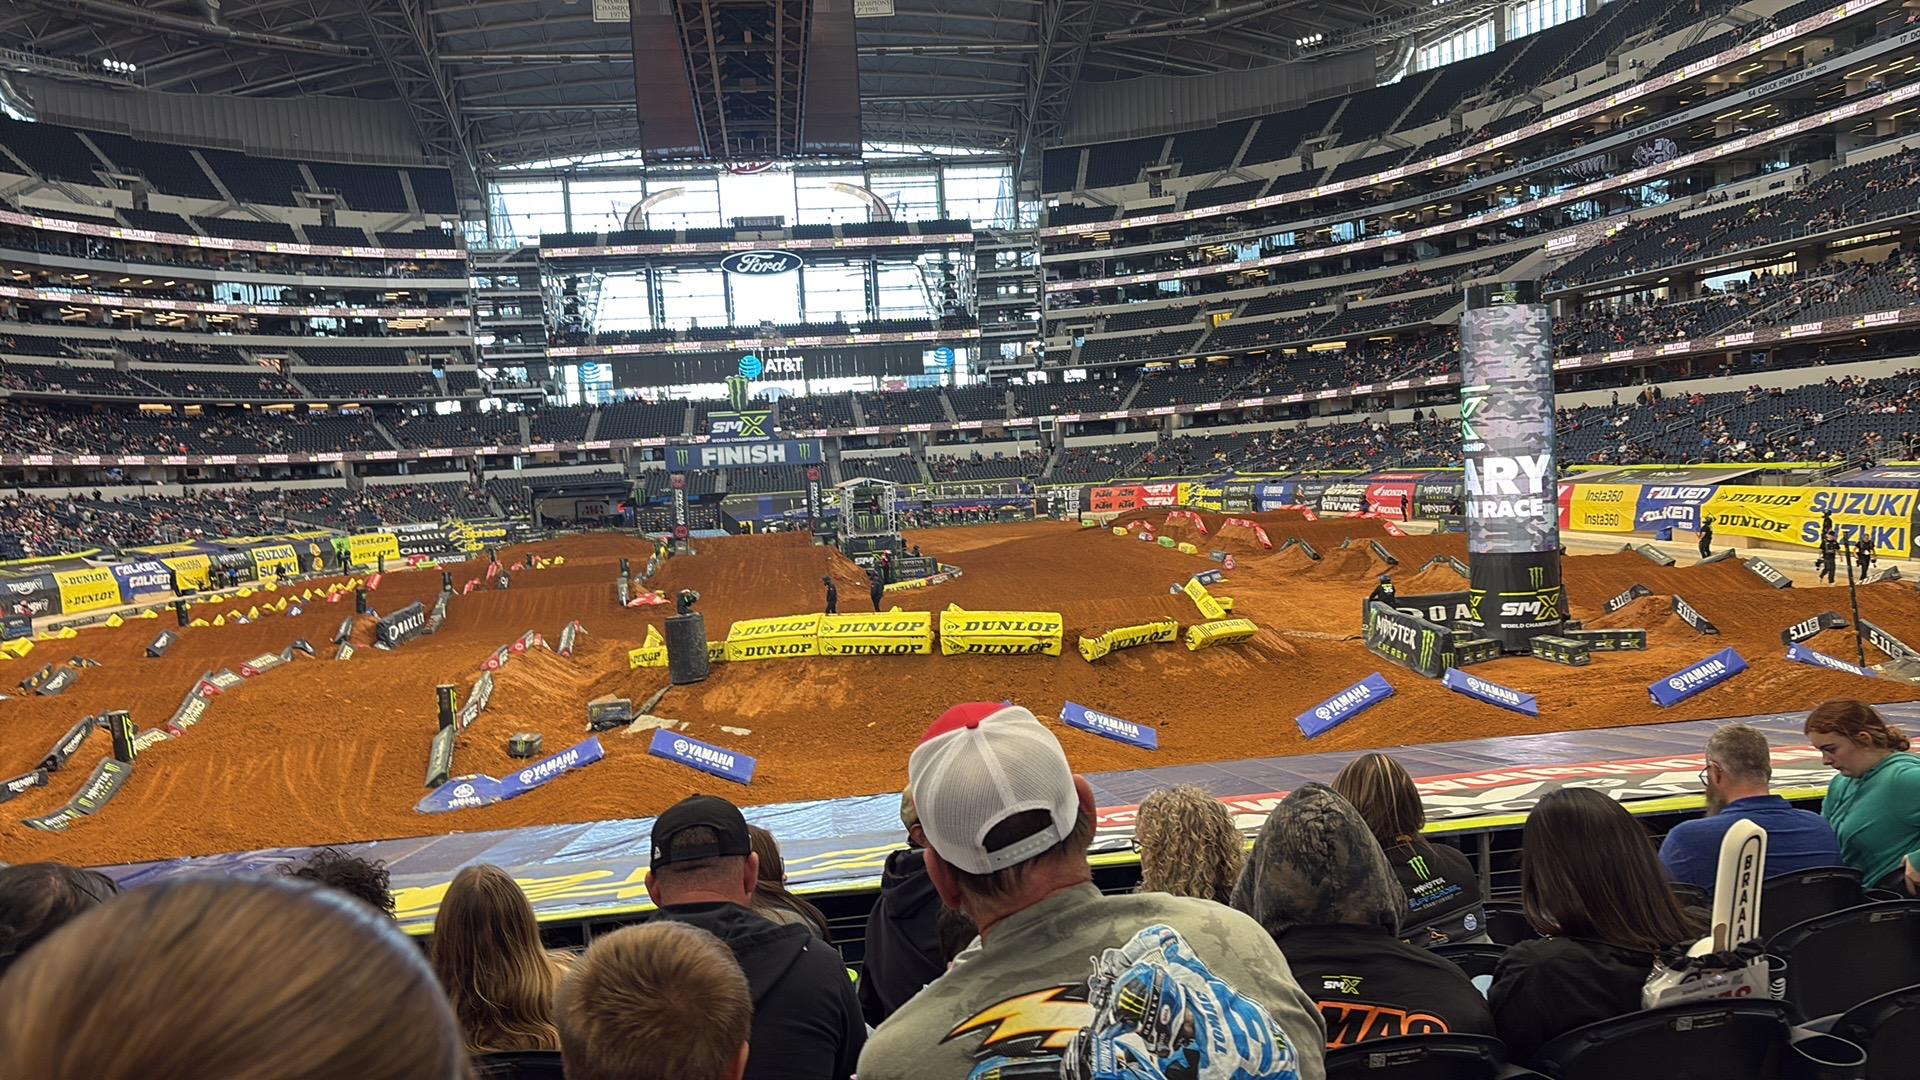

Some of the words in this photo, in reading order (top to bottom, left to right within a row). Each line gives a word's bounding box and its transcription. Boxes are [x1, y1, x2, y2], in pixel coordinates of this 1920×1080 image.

[1761, 24, 1797, 45] MILITARY
[1684, 56, 1718, 77] MILITARY
[1615, 84, 1646, 100] MILITARY
[1748, 89, 1756, 97] 54
[1758, 81, 1778, 94] CHUCK
[1778, 72, 1805, 88] HOWLEY
[1551, 109, 1579, 123] MILITARY
[1636, 128, 1648, 137] MEL
[1649, 120, 1670, 133] RENFRO
[1429, 192, 1440, 200] BOB
[1440, 188, 1458, 198] HAYES
[1547, 234, 1577, 247] MILITARY
[737, 254, 788, 273] Ford
[1864, 310, 1900, 323] MILITARY
[765, 357, 804, 373] AT&T
[712, 416, 767, 437] SMX
[701, 444, 786, 466] FINISH
[1094, 490, 1113, 499] KTM
[1117, 488, 1136, 498] KTM
[1143, 484, 1176, 494] FLY
[1382, 489, 1408, 497] HONDA
[1423, 486, 1453, 495] MONSTER
[1585, 489, 1624, 503] Insta360
[1646, 486, 1711, 500] FALKEN
[1093, 501, 1113, 511] KTM
[1118, 500, 1136, 509] KTM
[1143, 496, 1176, 506] FLY
[1727, 493, 1802, 506] DUNLOP
[1810, 491, 1912, 517] SUZUKI
[1378, 506, 1403, 514] HOND
[1421, 504, 1451, 513] MONSTER
[1482, 499, 1544, 518] RACE
[1640, 506, 1694, 522] FALKEN
[1584, 512, 1619, 527] Insta360
[1718, 514, 1791, 533] DUNLOP
[398, 533, 446, 542] OAKLEY
[255, 547, 295, 561] SUZUKI
[115, 561, 162, 576] FALKEN
[69, 572, 109, 585] DUNLOP
[129, 574, 171, 589] FALKEN
[7, 579, 44, 595] TRIUMPH
[73, 591, 116, 606] DUNLOP
[1500, 593, 1559, 621] SMX
[388, 612, 425, 641] OAKLEY
[744, 621, 816, 636] DUNLOP
[837, 621, 926, 633] DUNLOP
[963, 620, 1060, 633] DUNLOP
[1376, 614, 1417, 650] MONSTER
[1110, 629, 1172, 651] DUNLOP
[745, 643, 812, 657] DUNLOP
[840, 644, 923, 655] DUNLOP
[967, 642, 1053, 655] DUNLOP
[1378, 641, 1408, 661] ENERGY
[1681, 659, 1726, 685] YAMAHA
[1328, 684, 1371, 713] YAMAHA
[1478, 681, 1521, 704] YAMAHA
[1096, 713, 1140, 737] YAMAHA
[688, 742, 735, 769] YAMAHA
[533, 749, 579, 780] YAMAHA
[447, 796, 481, 809] YAMAHA
[1412, 877, 1446, 894] MONSTER
[1408, 884, 1463, 909] SUPERCROSS
[1736, 855, 1753, 948] BRAAA
[1323, 979, 1360, 995] SMX
[1200, 991, 1228, 1055] TOMAC
